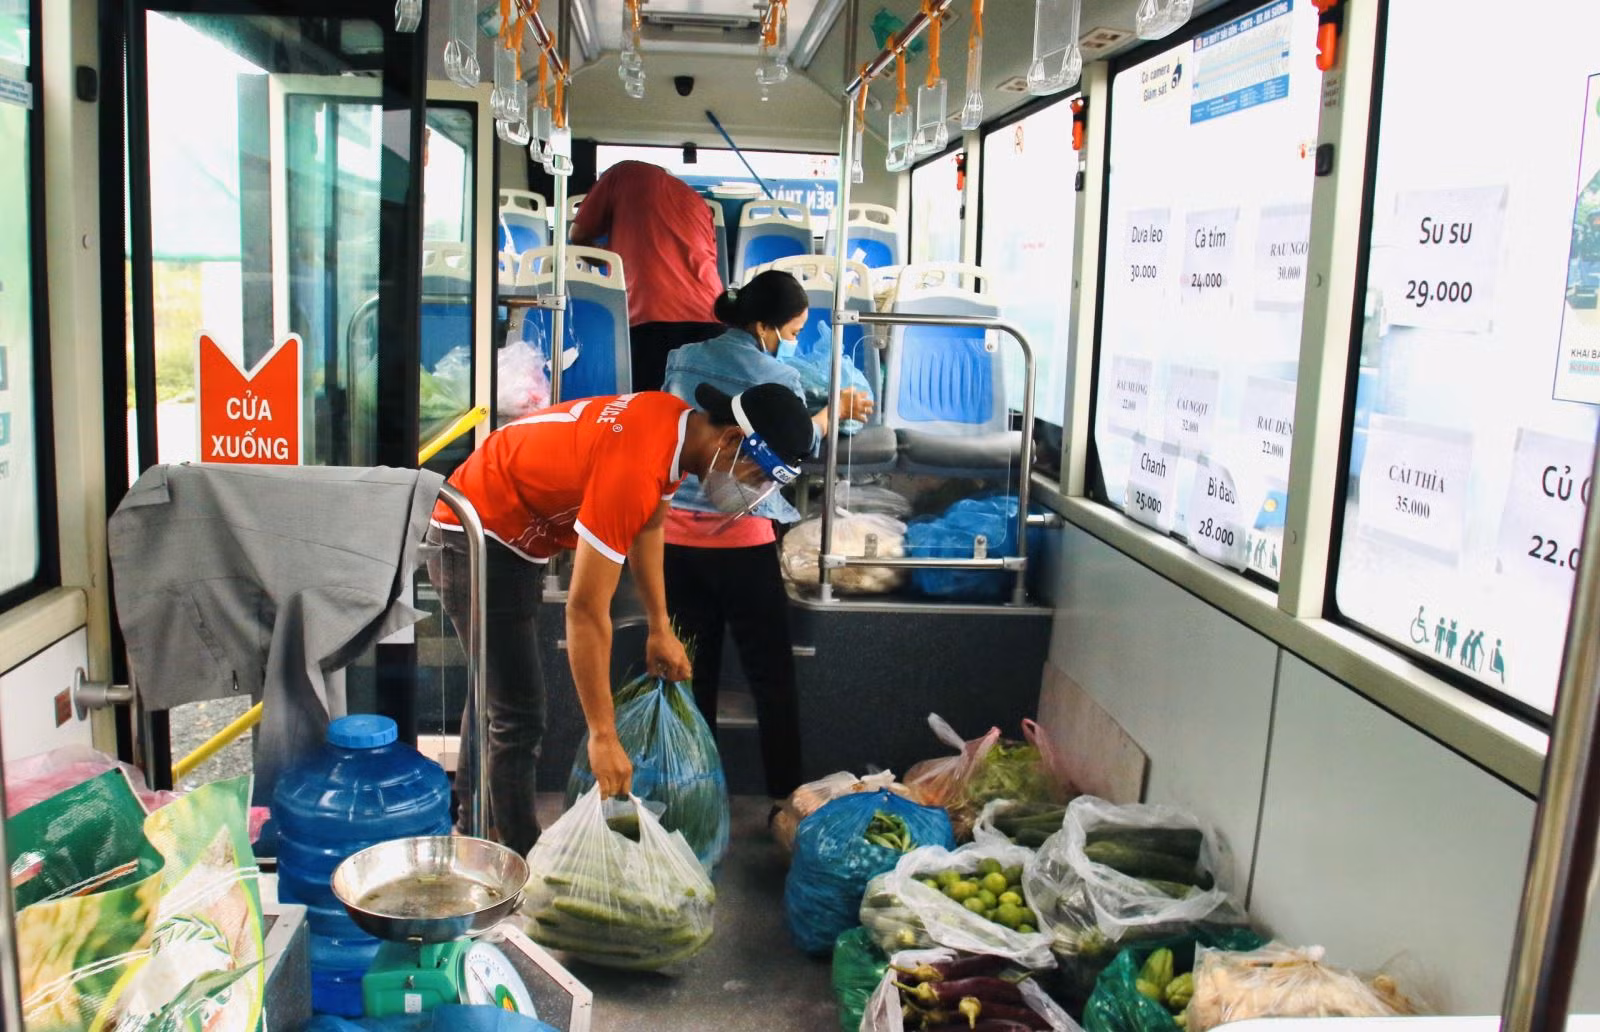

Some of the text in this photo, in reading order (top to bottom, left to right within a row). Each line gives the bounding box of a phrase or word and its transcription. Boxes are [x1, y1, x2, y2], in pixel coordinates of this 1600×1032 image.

[1150, 223, 1163, 243] leo
[1195, 225, 1226, 248] Cà tím
[1419, 217, 1472, 244] Su su
[1270, 242, 1288, 257] RAU
[1131, 265, 1157, 282] 30.000
[1191, 273, 1222, 293] 24.000
[1277, 265, 1301, 281] 30.000
[1405, 280, 1473, 308] 29.000
[226, 389, 273, 421] CỬA
[1257, 416, 1273, 432] RAU
[211, 427, 289, 460] XUỐNG
[1262, 440, 1284, 459] 22.000
[1140, 452, 1166, 478] Chanh
[1542, 465, 1572, 501] Củ
[1136, 491, 1162, 514] 25.000
[1395, 495, 1430, 519] 35.000
[1198, 518, 1234, 546] 28.000
